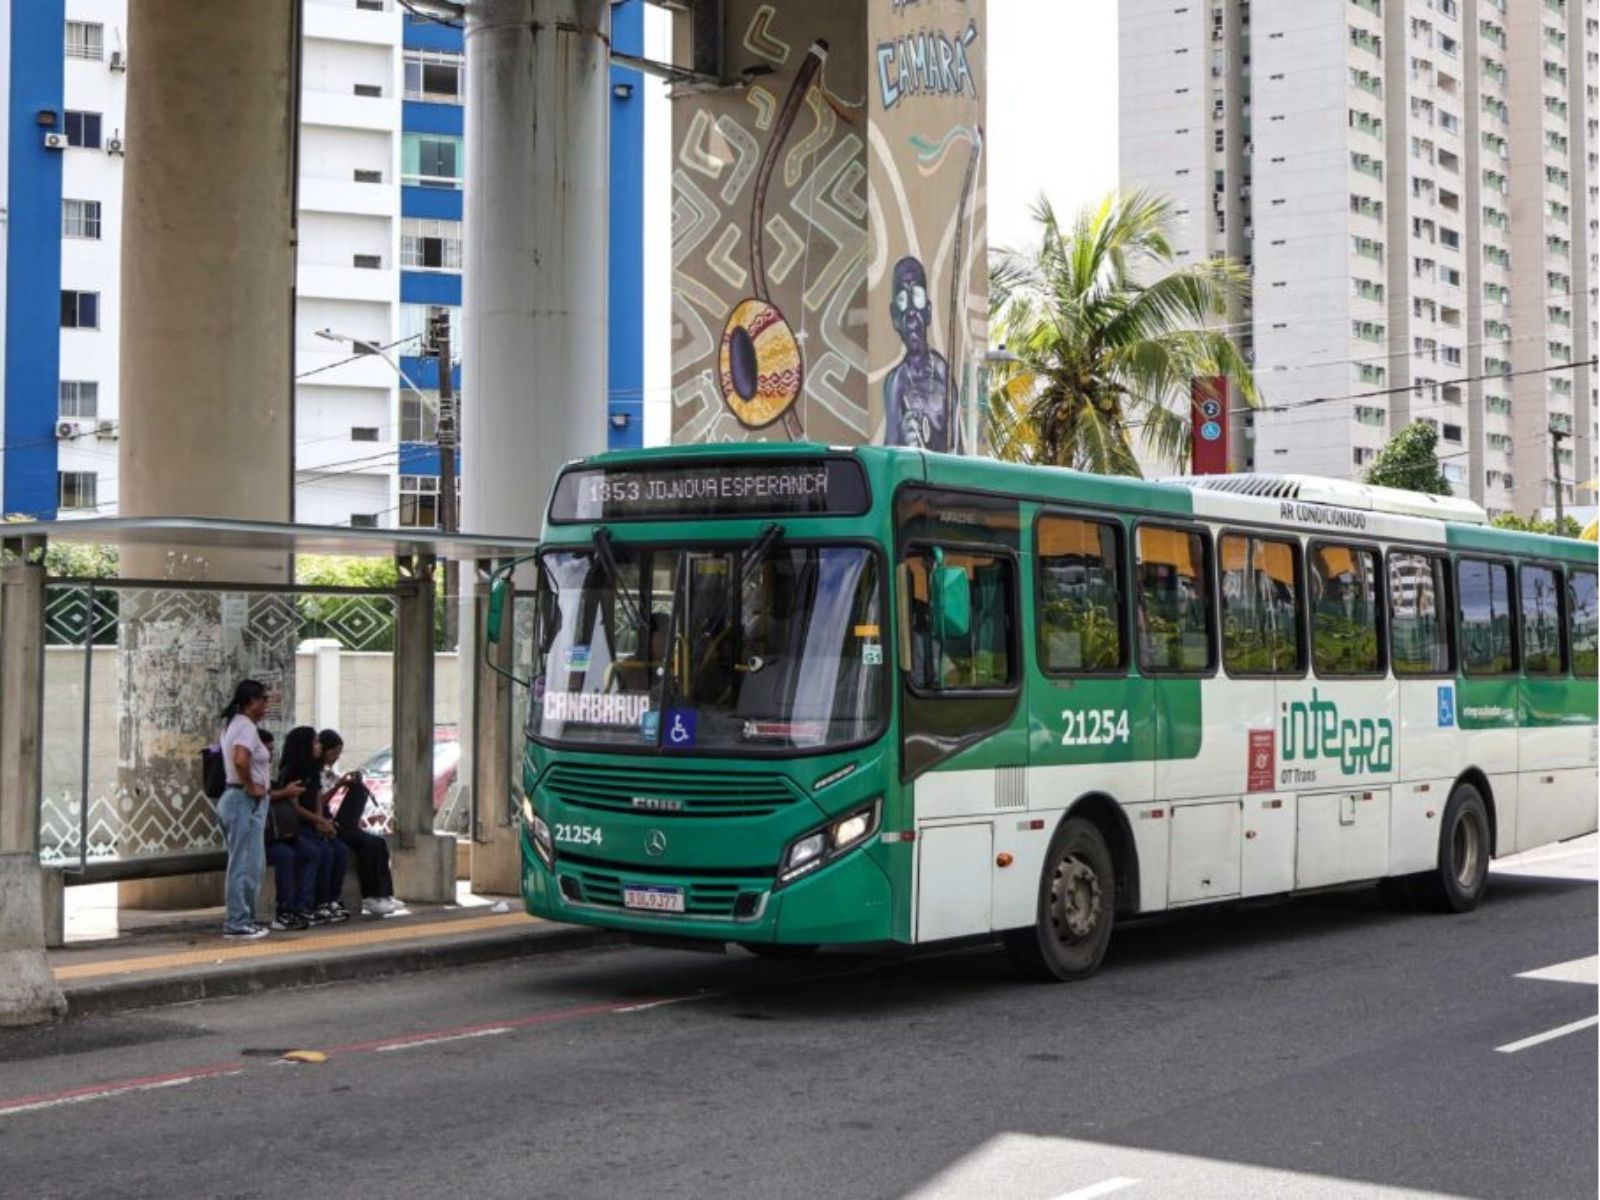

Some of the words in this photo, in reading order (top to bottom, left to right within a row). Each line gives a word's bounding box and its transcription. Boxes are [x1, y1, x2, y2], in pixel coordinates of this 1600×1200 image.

[877, 20, 978, 110] CAMARÁ
[1280, 502, 1294, 520] AR
[1296, 505, 1366, 529] CONDICIONADO
[1061, 709, 1130, 745] 21254
[554, 823, 603, 845] 21254
